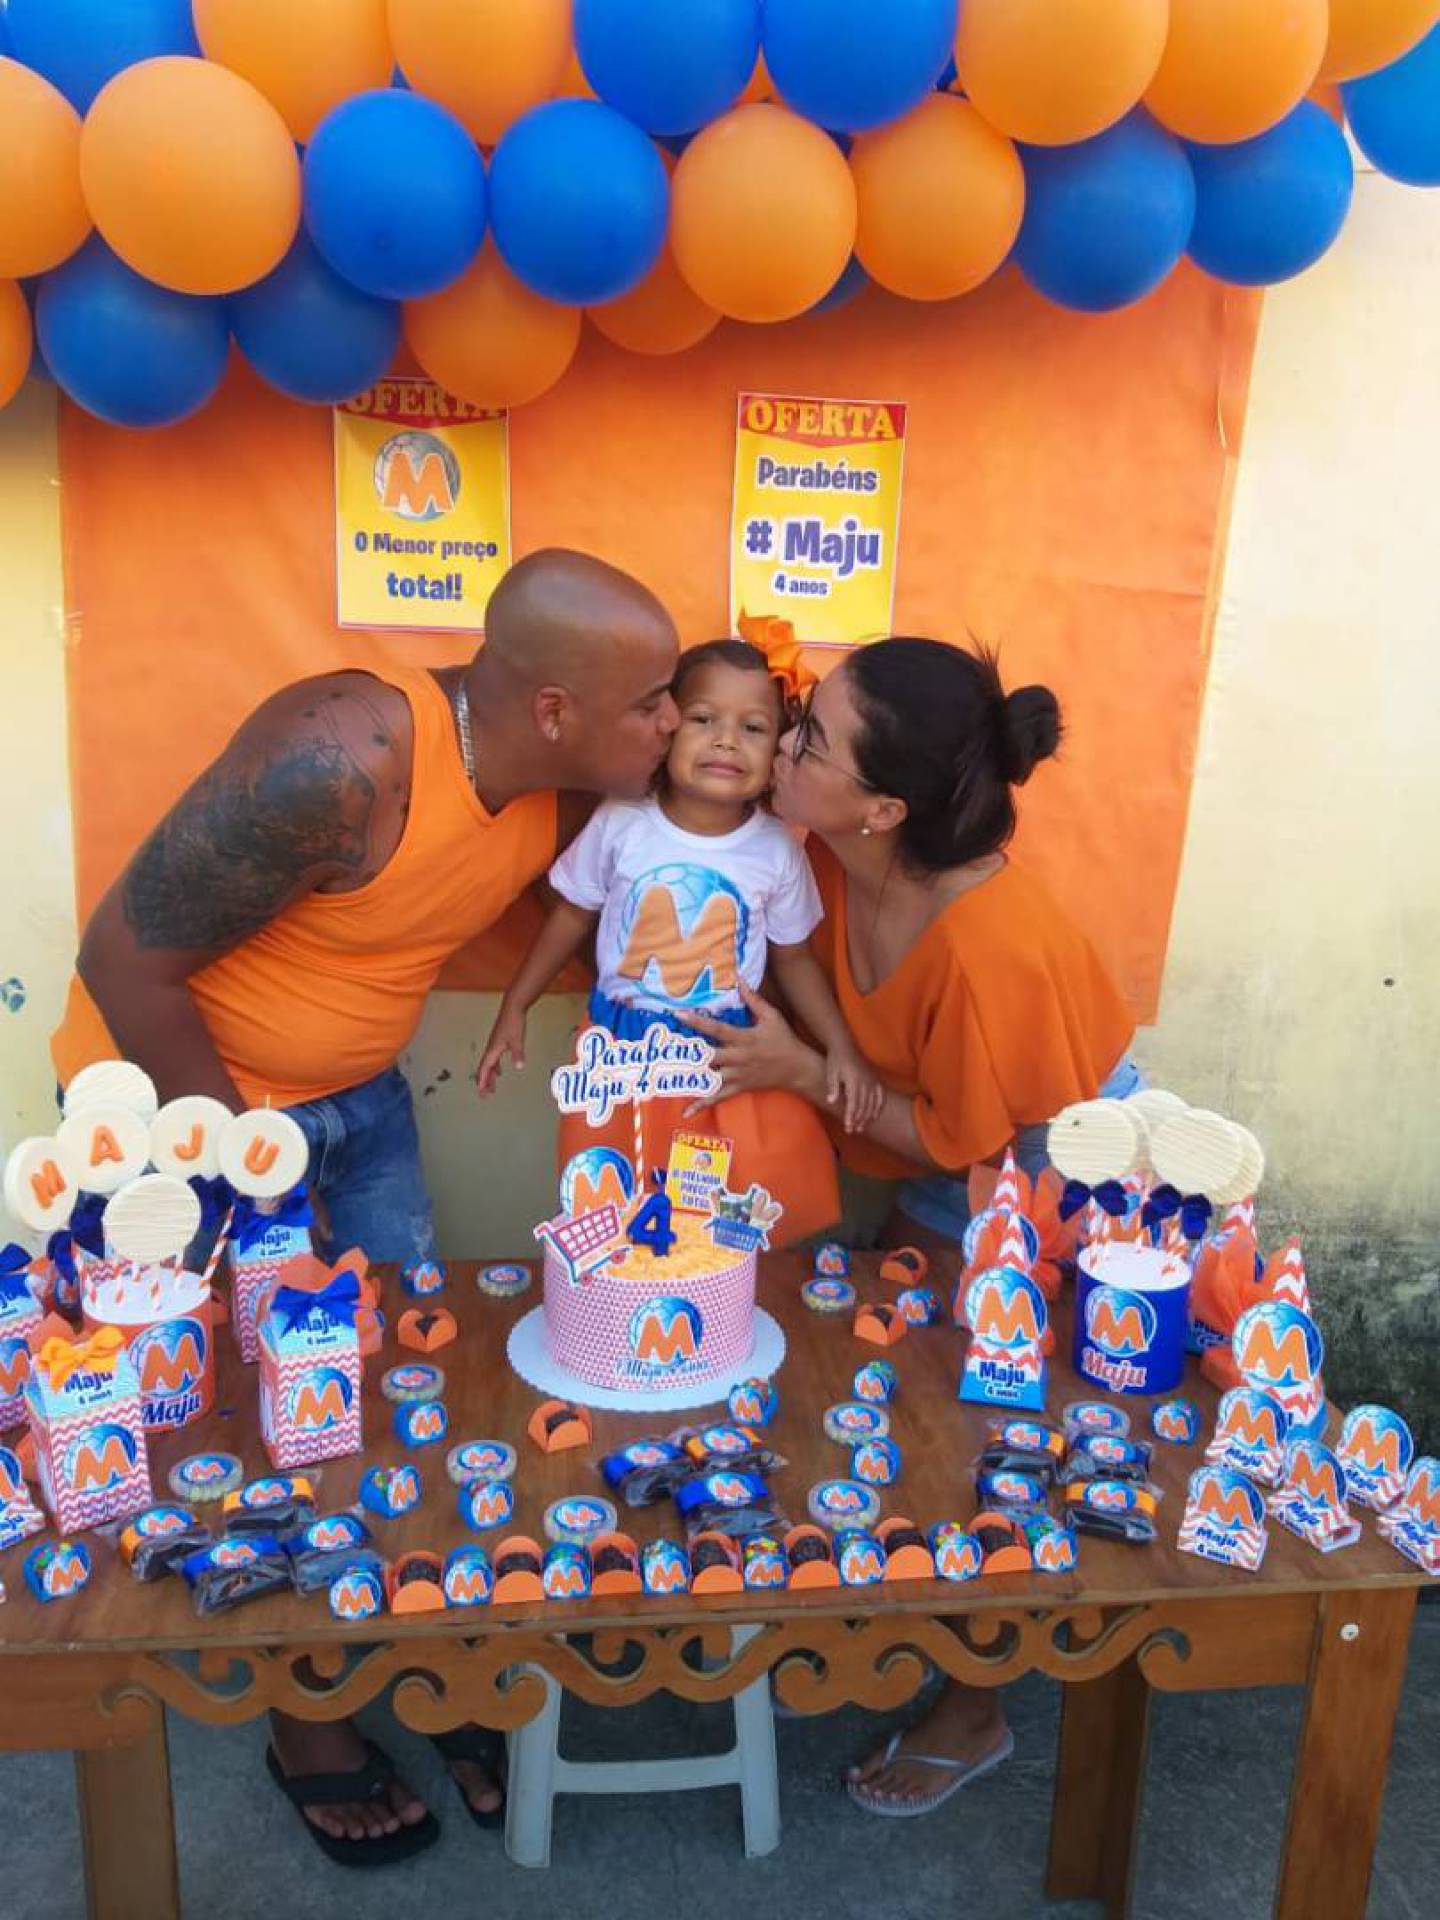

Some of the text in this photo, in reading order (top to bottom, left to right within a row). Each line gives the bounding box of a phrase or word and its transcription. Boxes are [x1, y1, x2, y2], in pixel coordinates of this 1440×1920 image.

[746, 399, 896, 438] OFERTA
[757, 457, 878, 491] Parabéns
[355, 531, 498, 563] O Menor preço
[746, 519, 880, 577] # Maju
[386, 571, 463, 601] total!
[774, 574, 828, 595] 4 anos
[656, 1072, 712, 1092] anos
[626, 1192, 678, 1258] 4
[979, 1361, 1025, 1387] Maju
[1084, 1350, 1146, 1391] Maju
[141, 1393, 201, 1425] Maju
